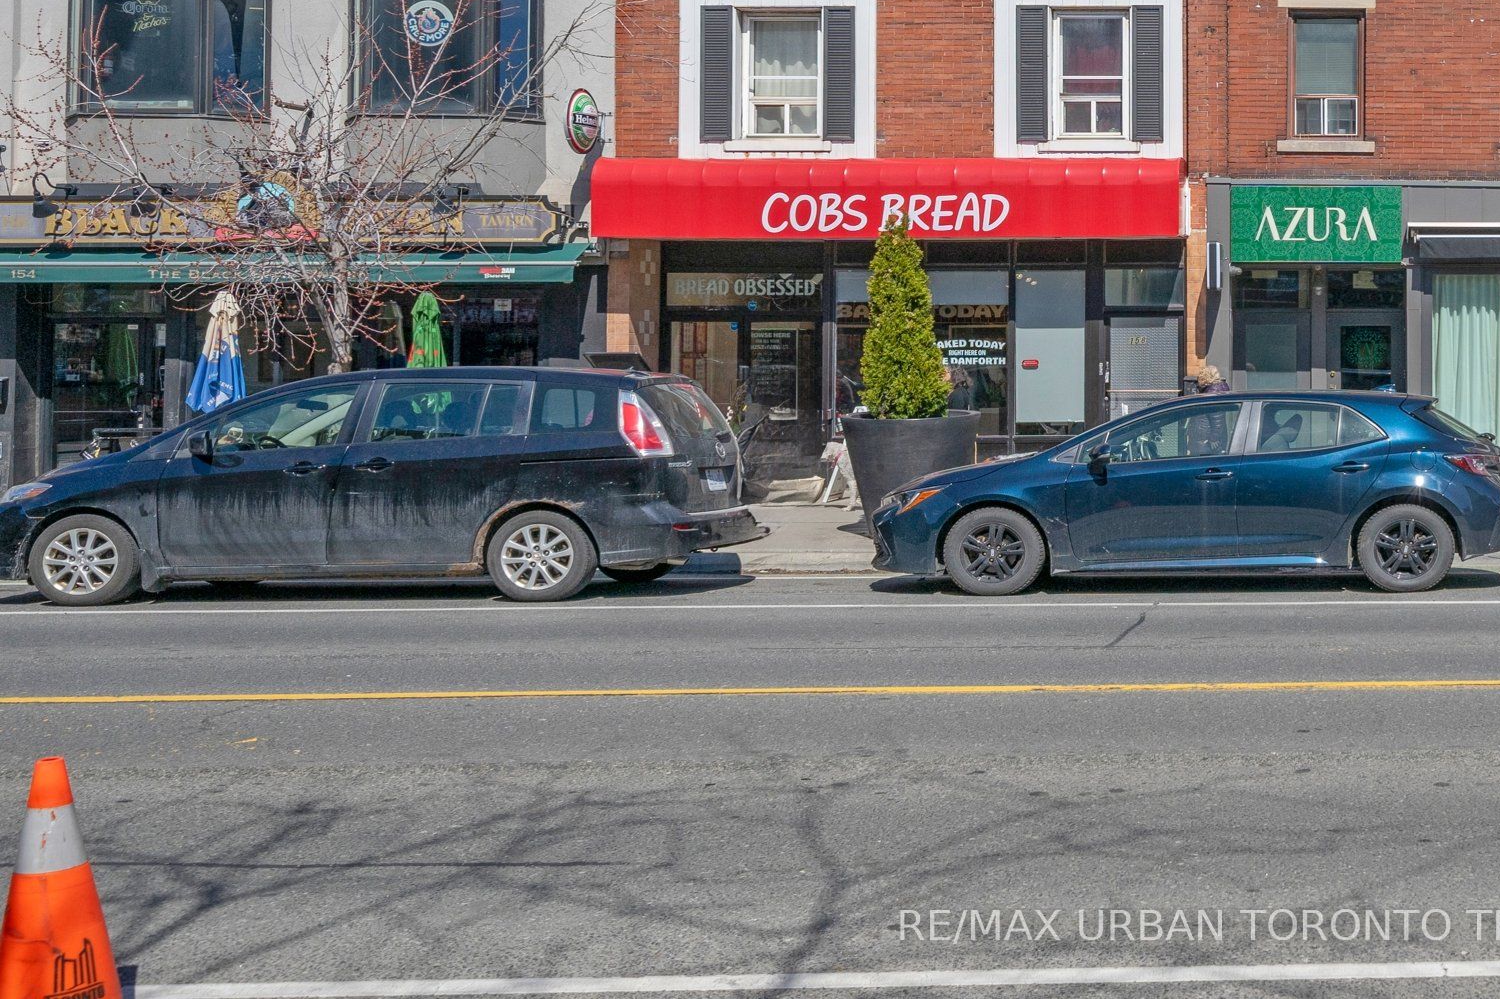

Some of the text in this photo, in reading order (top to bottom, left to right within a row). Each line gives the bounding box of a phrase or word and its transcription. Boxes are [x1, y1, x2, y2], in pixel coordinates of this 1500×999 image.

[122, 1, 169, 15] Corona
[761, 192, 1010, 233] COBS BREAD
[45, 208, 189, 236] BLACK
[480, 213, 534, 229] TAVERN
[1254, 206, 1378, 242] AZURA
[11, 269, 36, 279] 154
[675, 279, 816, 296] BREAD OBSESSED
[934, 339, 1006, 350] AKED TODAY
[950, 357, 1007, 365] DANFORTH
